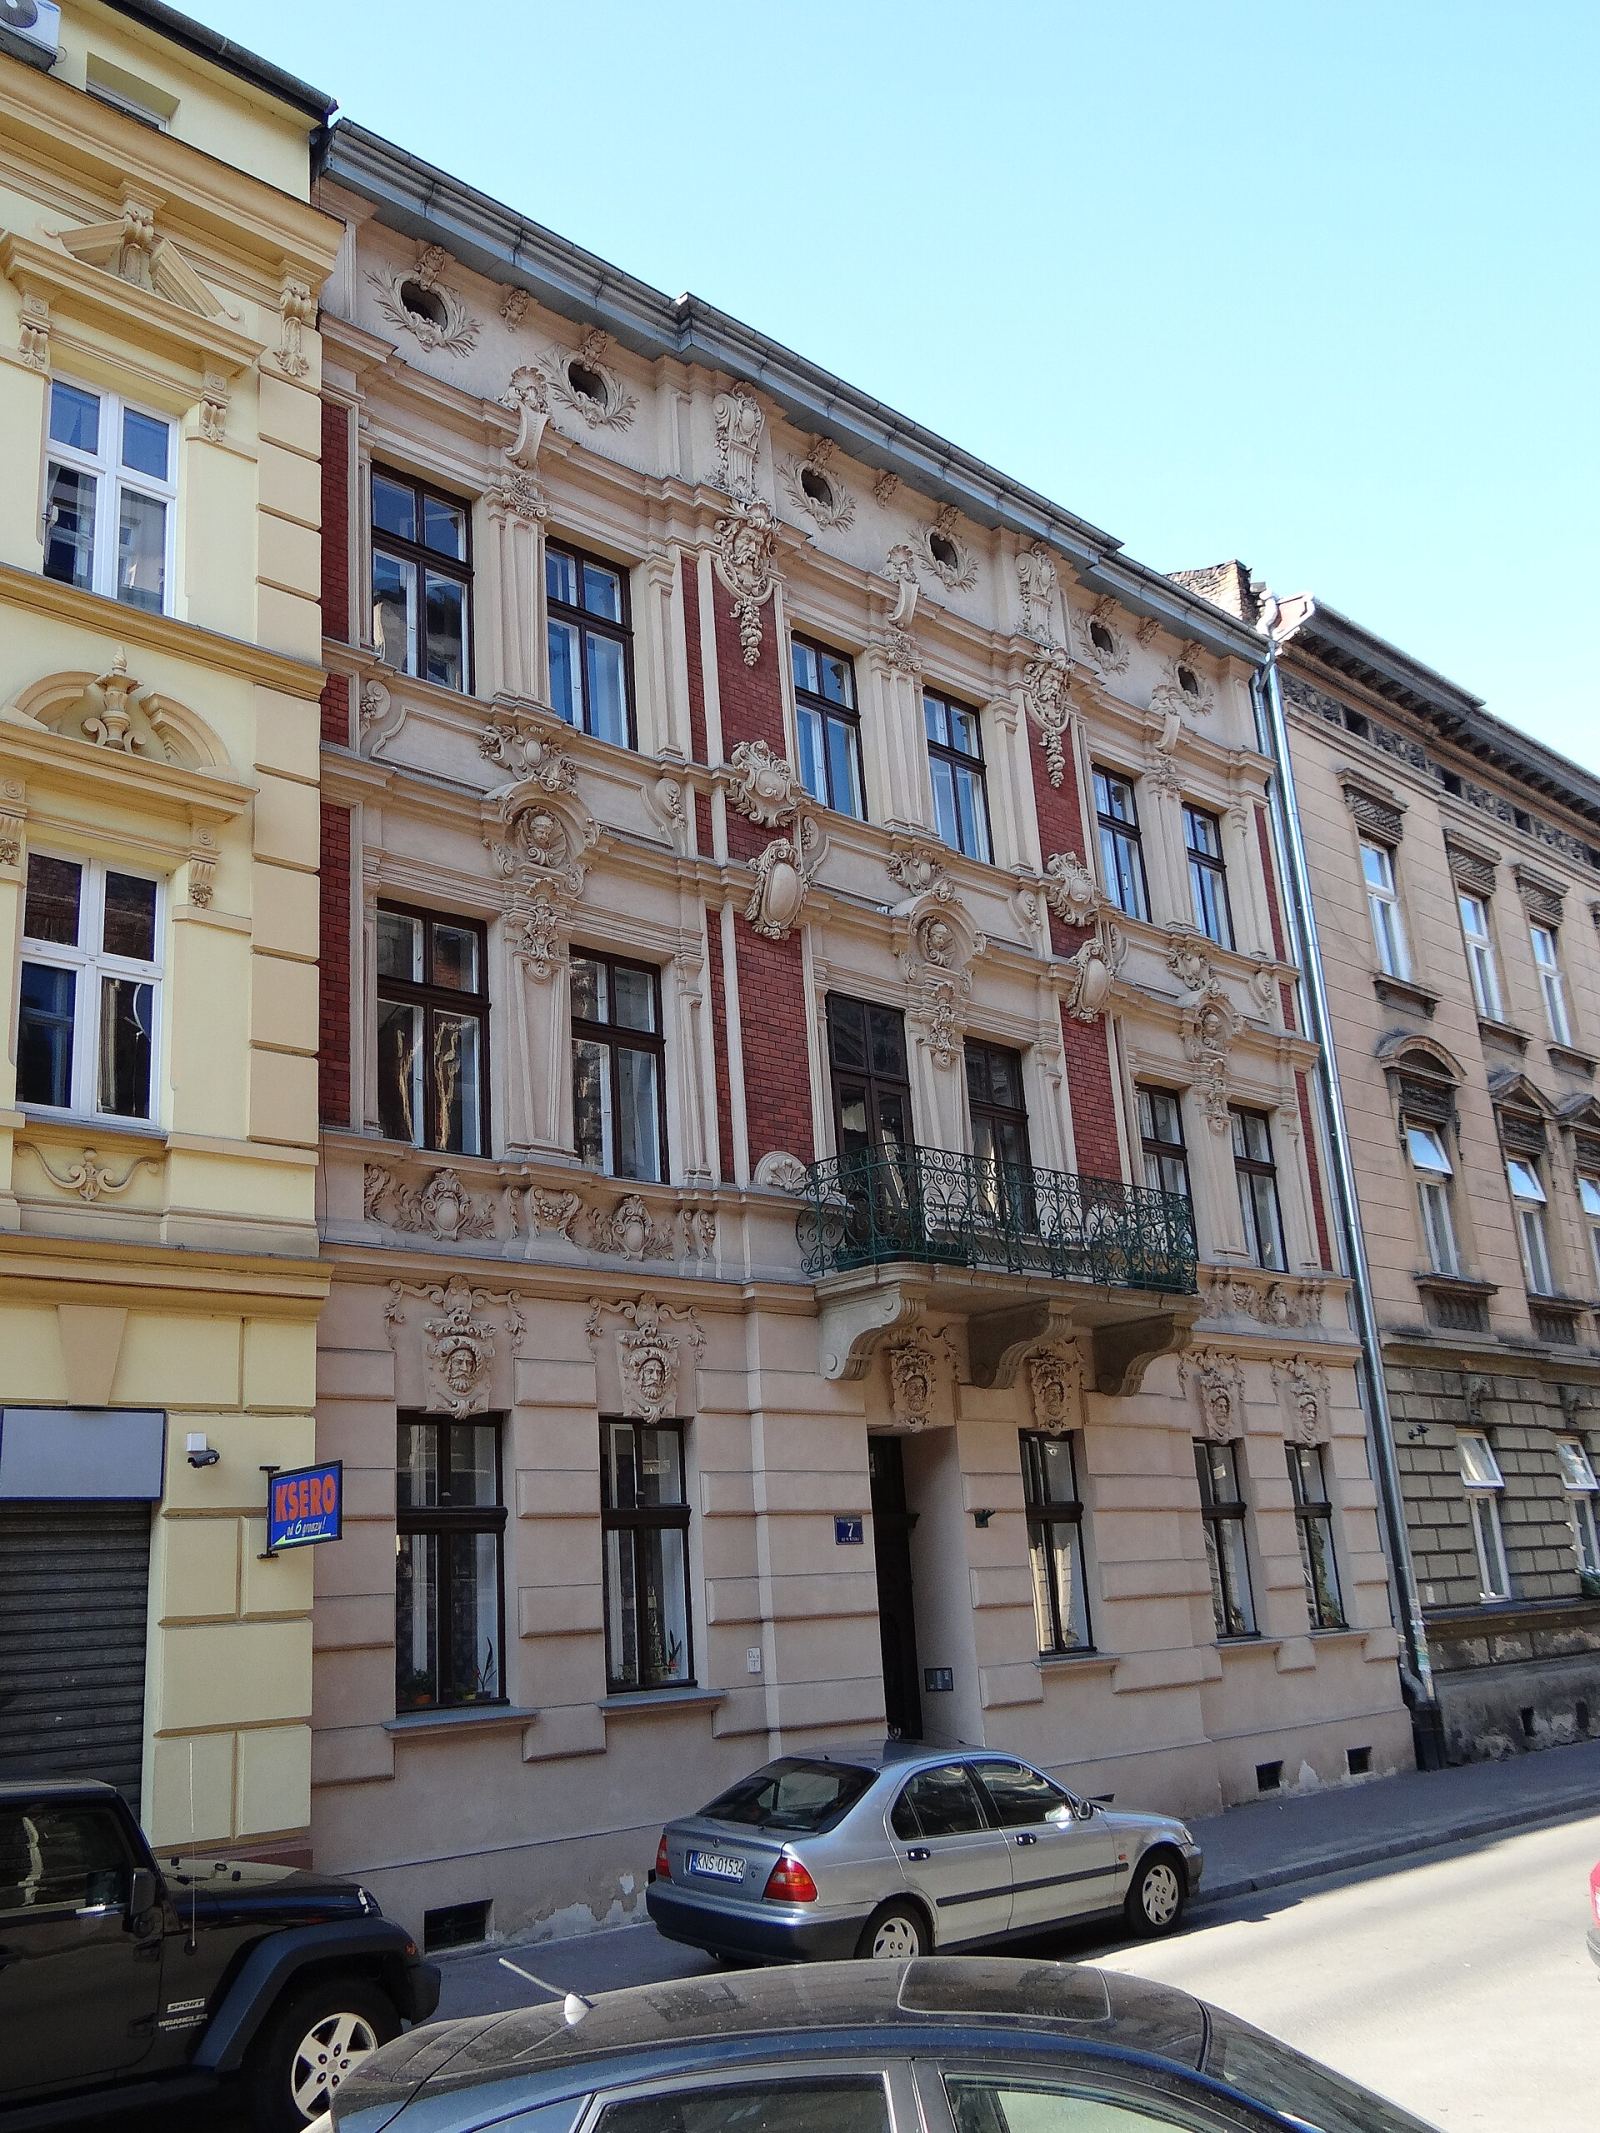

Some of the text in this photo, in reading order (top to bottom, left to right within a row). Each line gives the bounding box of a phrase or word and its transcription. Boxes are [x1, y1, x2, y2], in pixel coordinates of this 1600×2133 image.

[275, 1474, 336, 1522] KSERO
[295, 1520, 302, 1535] 6
[847, 1522, 854, 1537] 7
[697, 1853, 745, 1876] KNS 01534
[170, 2000, 203, 2010] SPORT
[158, 2013, 208, 2027] WRANGLER
